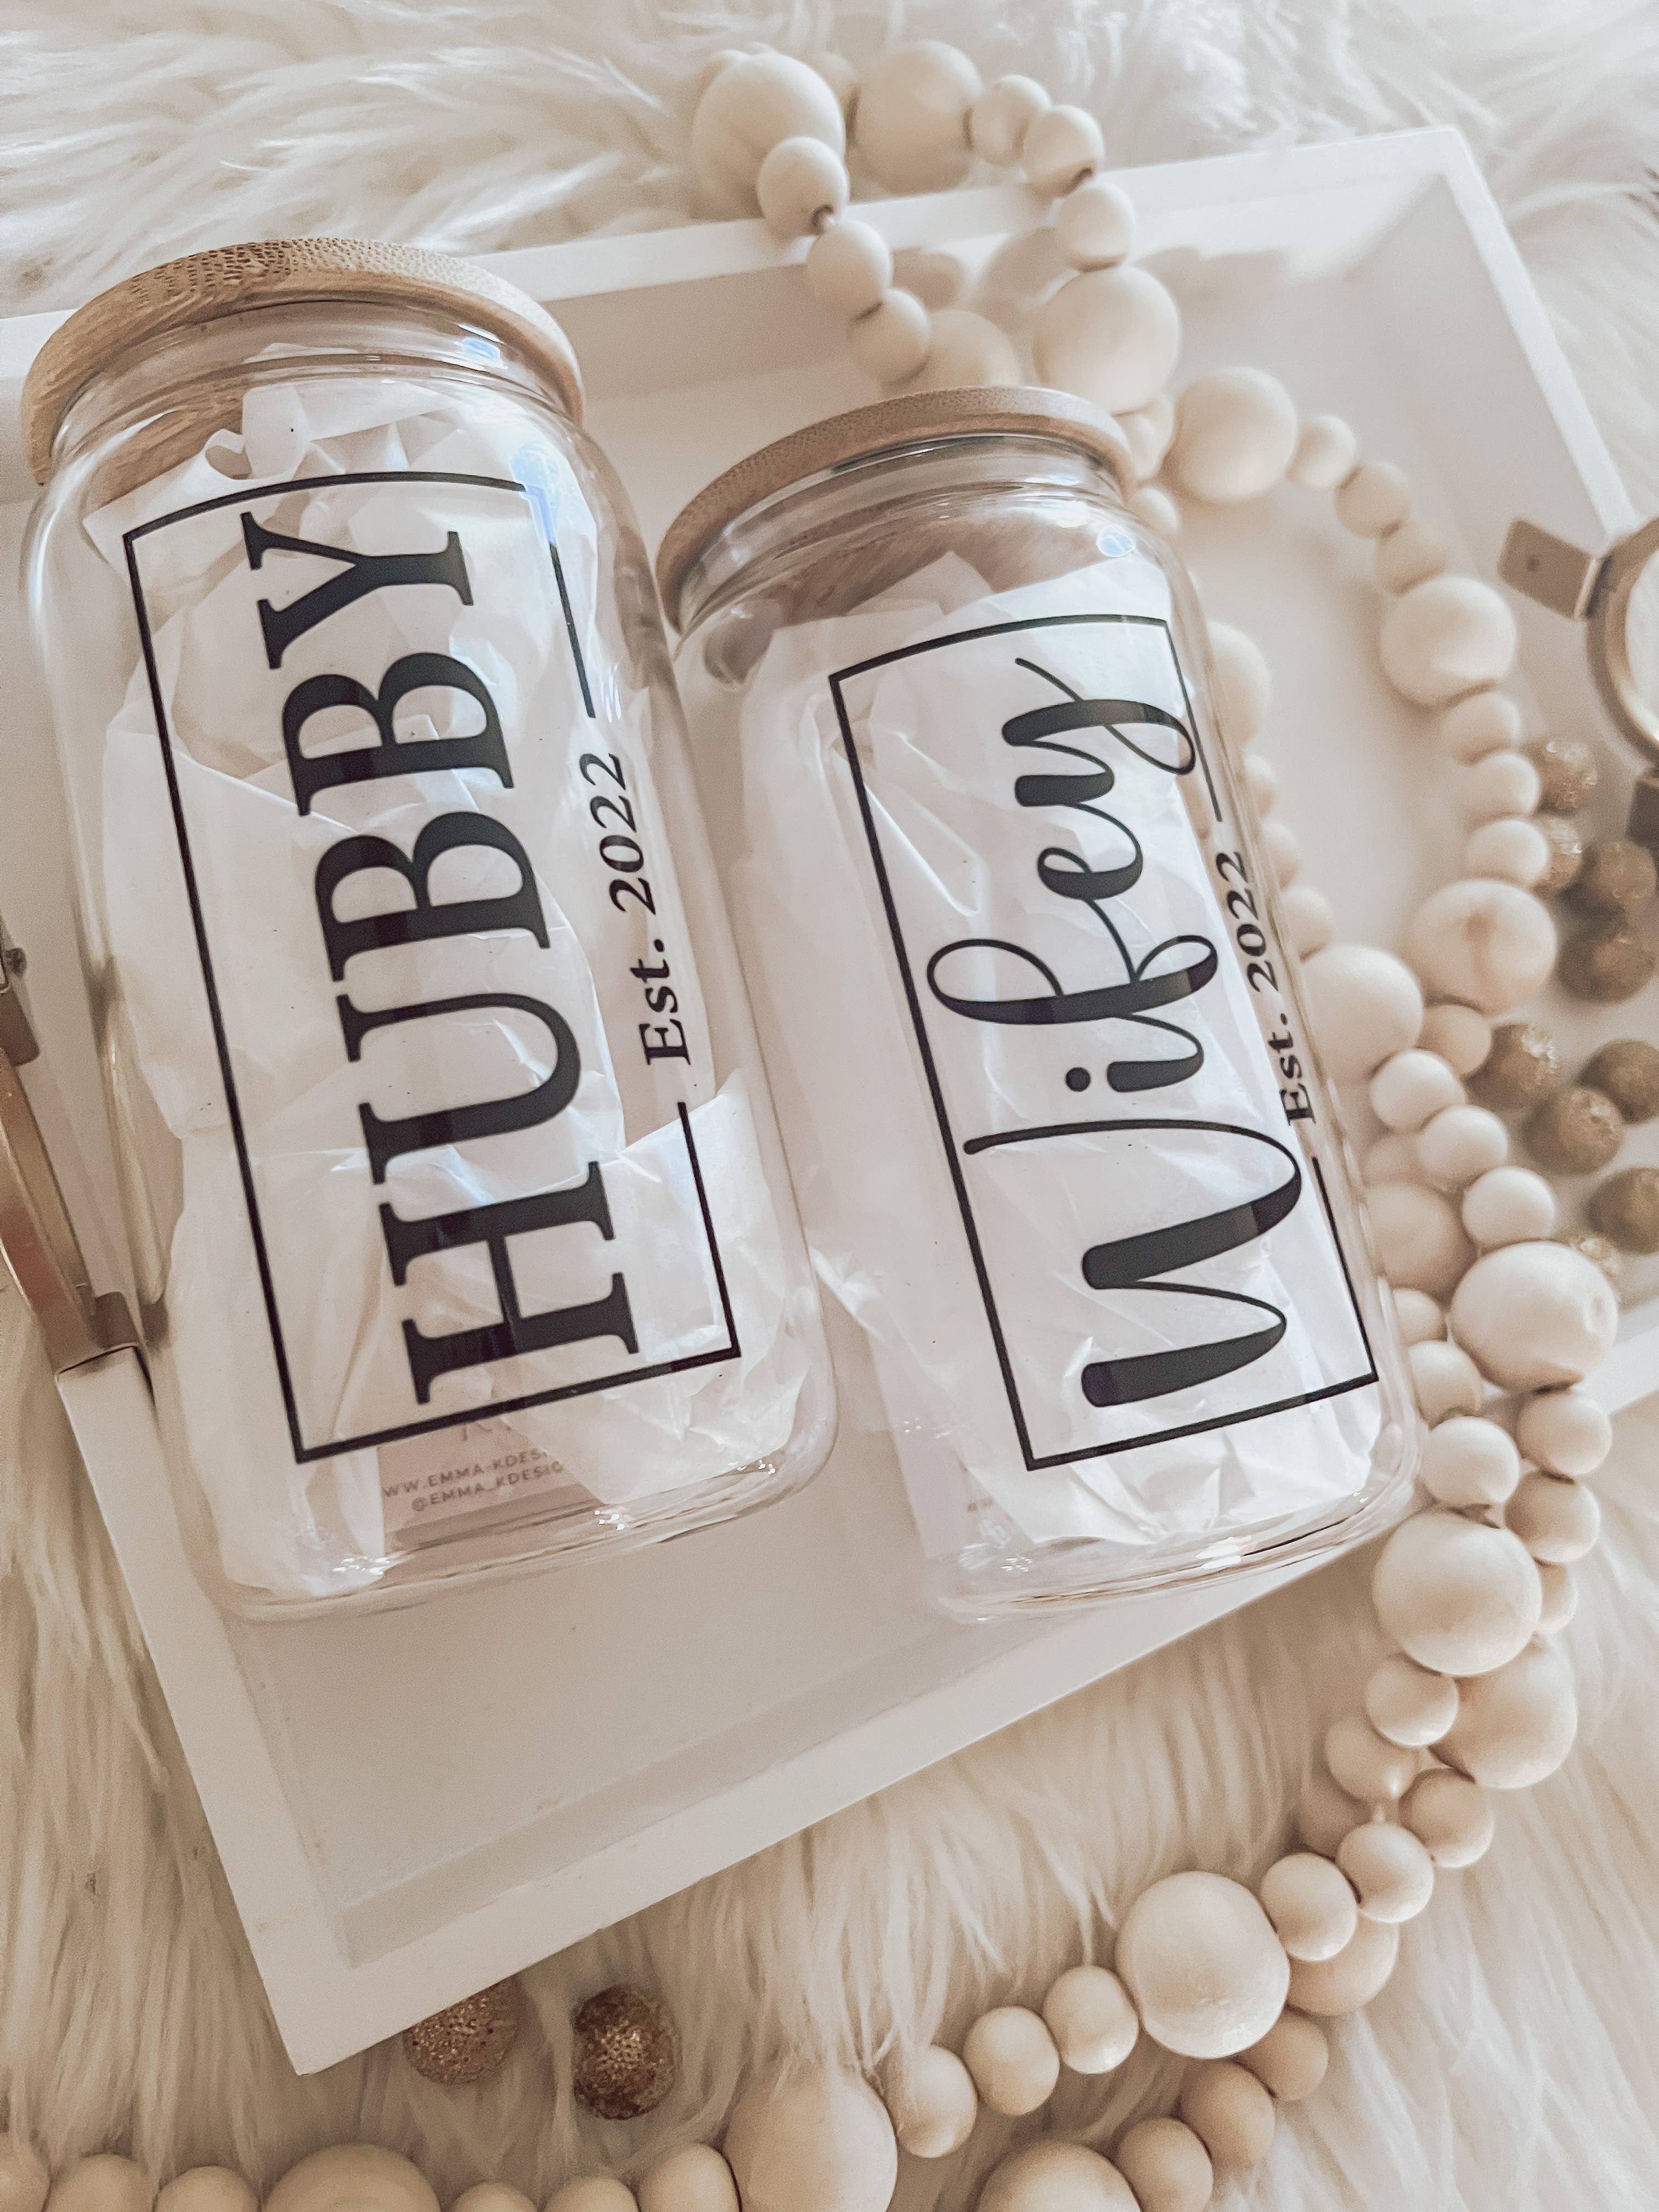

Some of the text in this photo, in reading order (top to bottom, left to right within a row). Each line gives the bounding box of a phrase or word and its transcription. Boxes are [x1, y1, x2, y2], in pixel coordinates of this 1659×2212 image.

[240, 511, 639, 1406] HUBBY
[578, 752, 691, 1066] Est. 2022
[927, 657, 1302, 1408] Wifey
[1215, 850, 1317, 1127] Est. 2022
